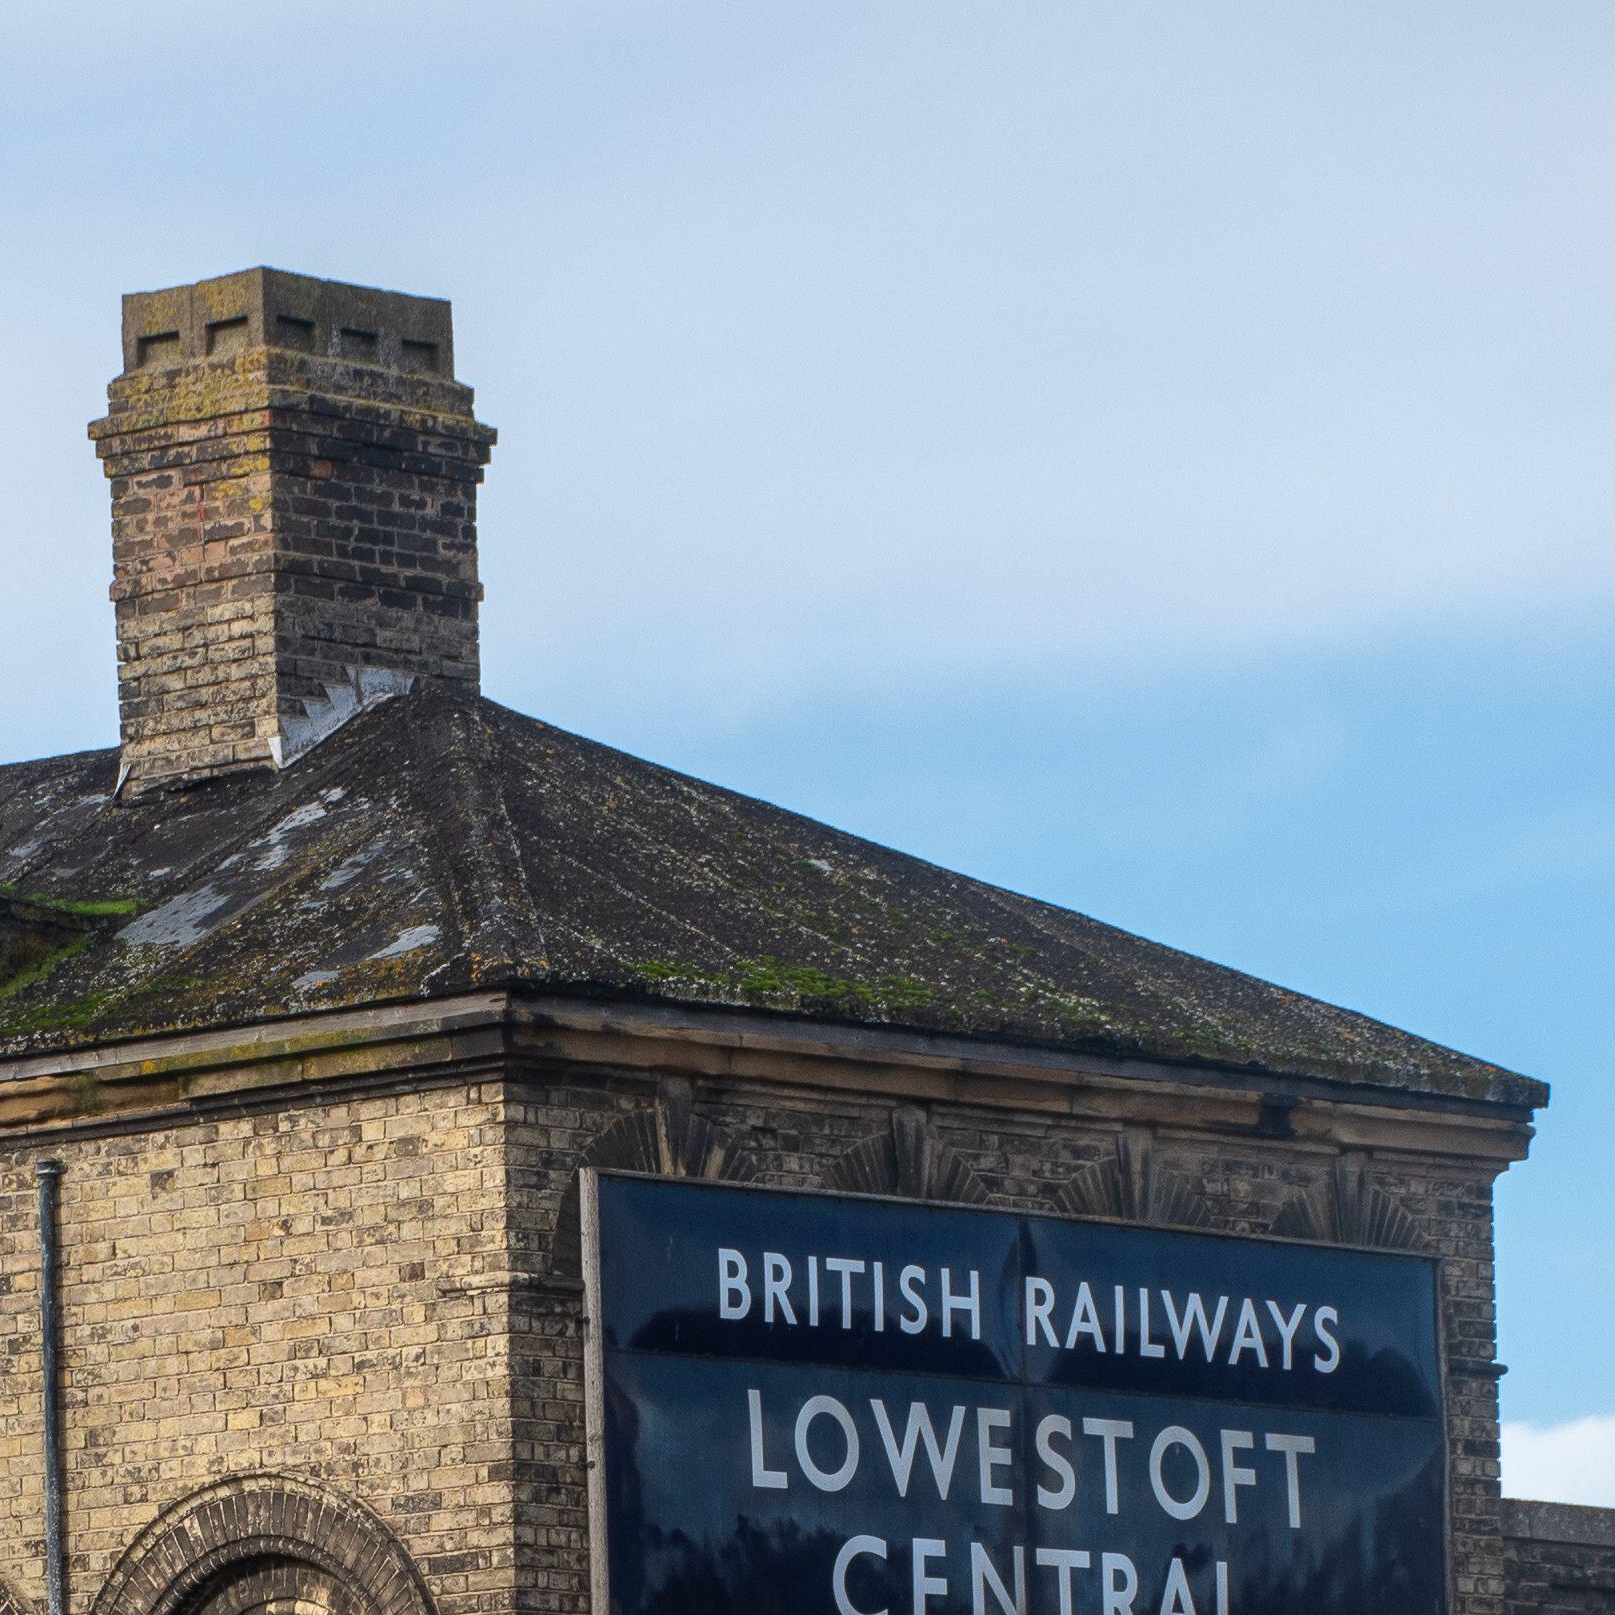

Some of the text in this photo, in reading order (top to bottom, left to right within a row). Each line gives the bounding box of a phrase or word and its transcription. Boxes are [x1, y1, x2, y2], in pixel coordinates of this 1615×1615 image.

[718, 1247, 1341, 1374] BRITISH RAILWAYS
[746, 1388, 1317, 1530] LOWESTOFT
